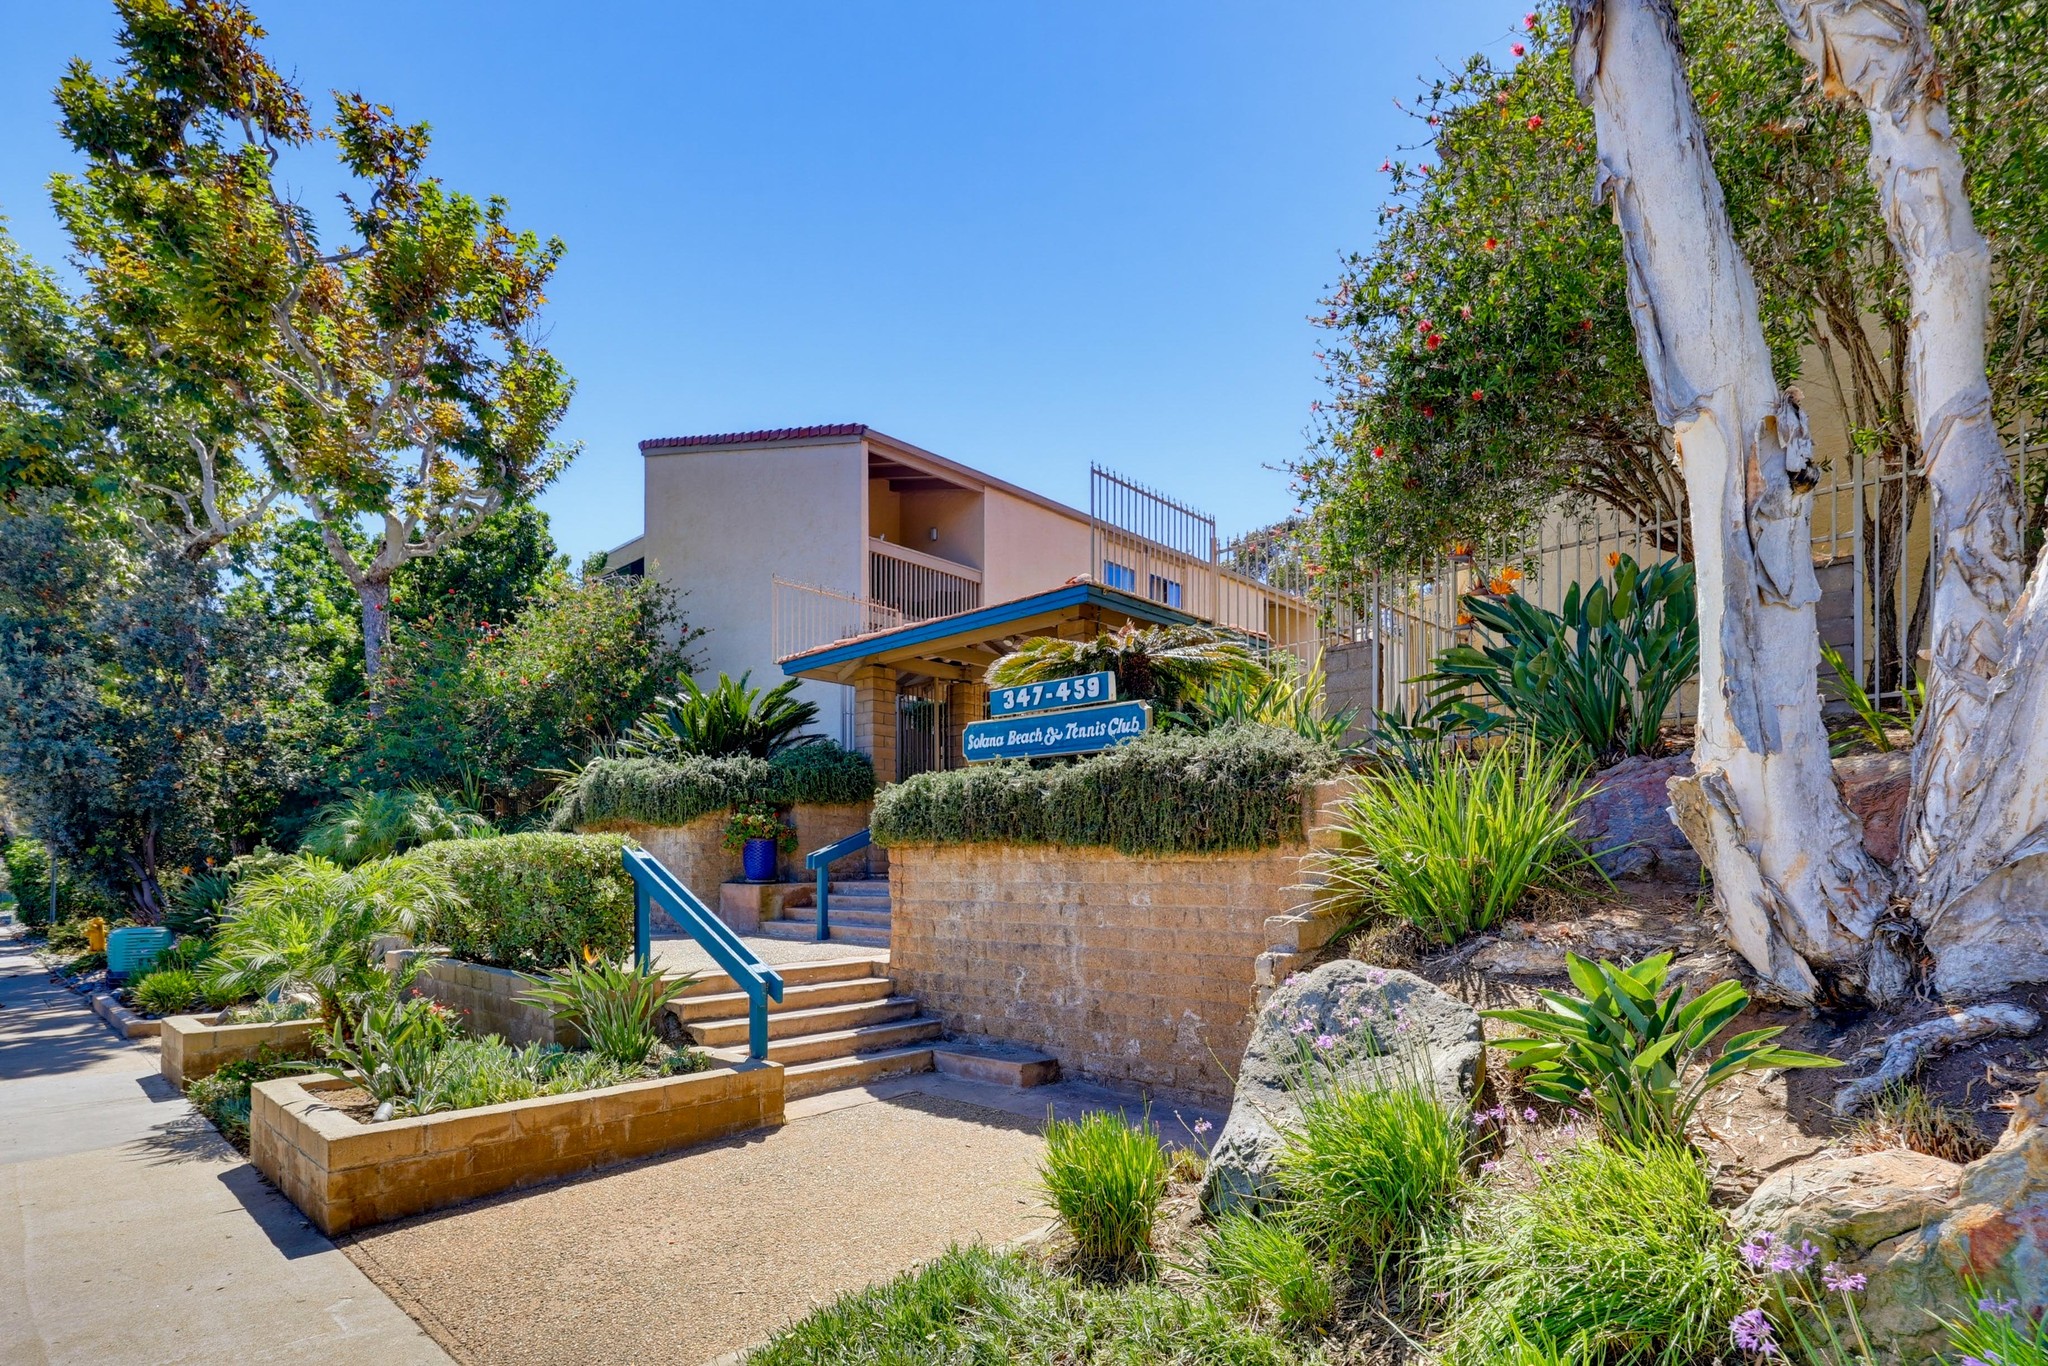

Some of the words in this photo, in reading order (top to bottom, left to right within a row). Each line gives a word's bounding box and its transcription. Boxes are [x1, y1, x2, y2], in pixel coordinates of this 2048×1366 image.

[1003, 676, 1100, 709] 347-459
[967, 733, 1004, 750] Solana
[1007, 727, 1042, 745] Beach
[1043, 726, 1063, 746] &
[1065, 721, 1106, 739] Tennis
[1107, 716, 1140, 735] Club
